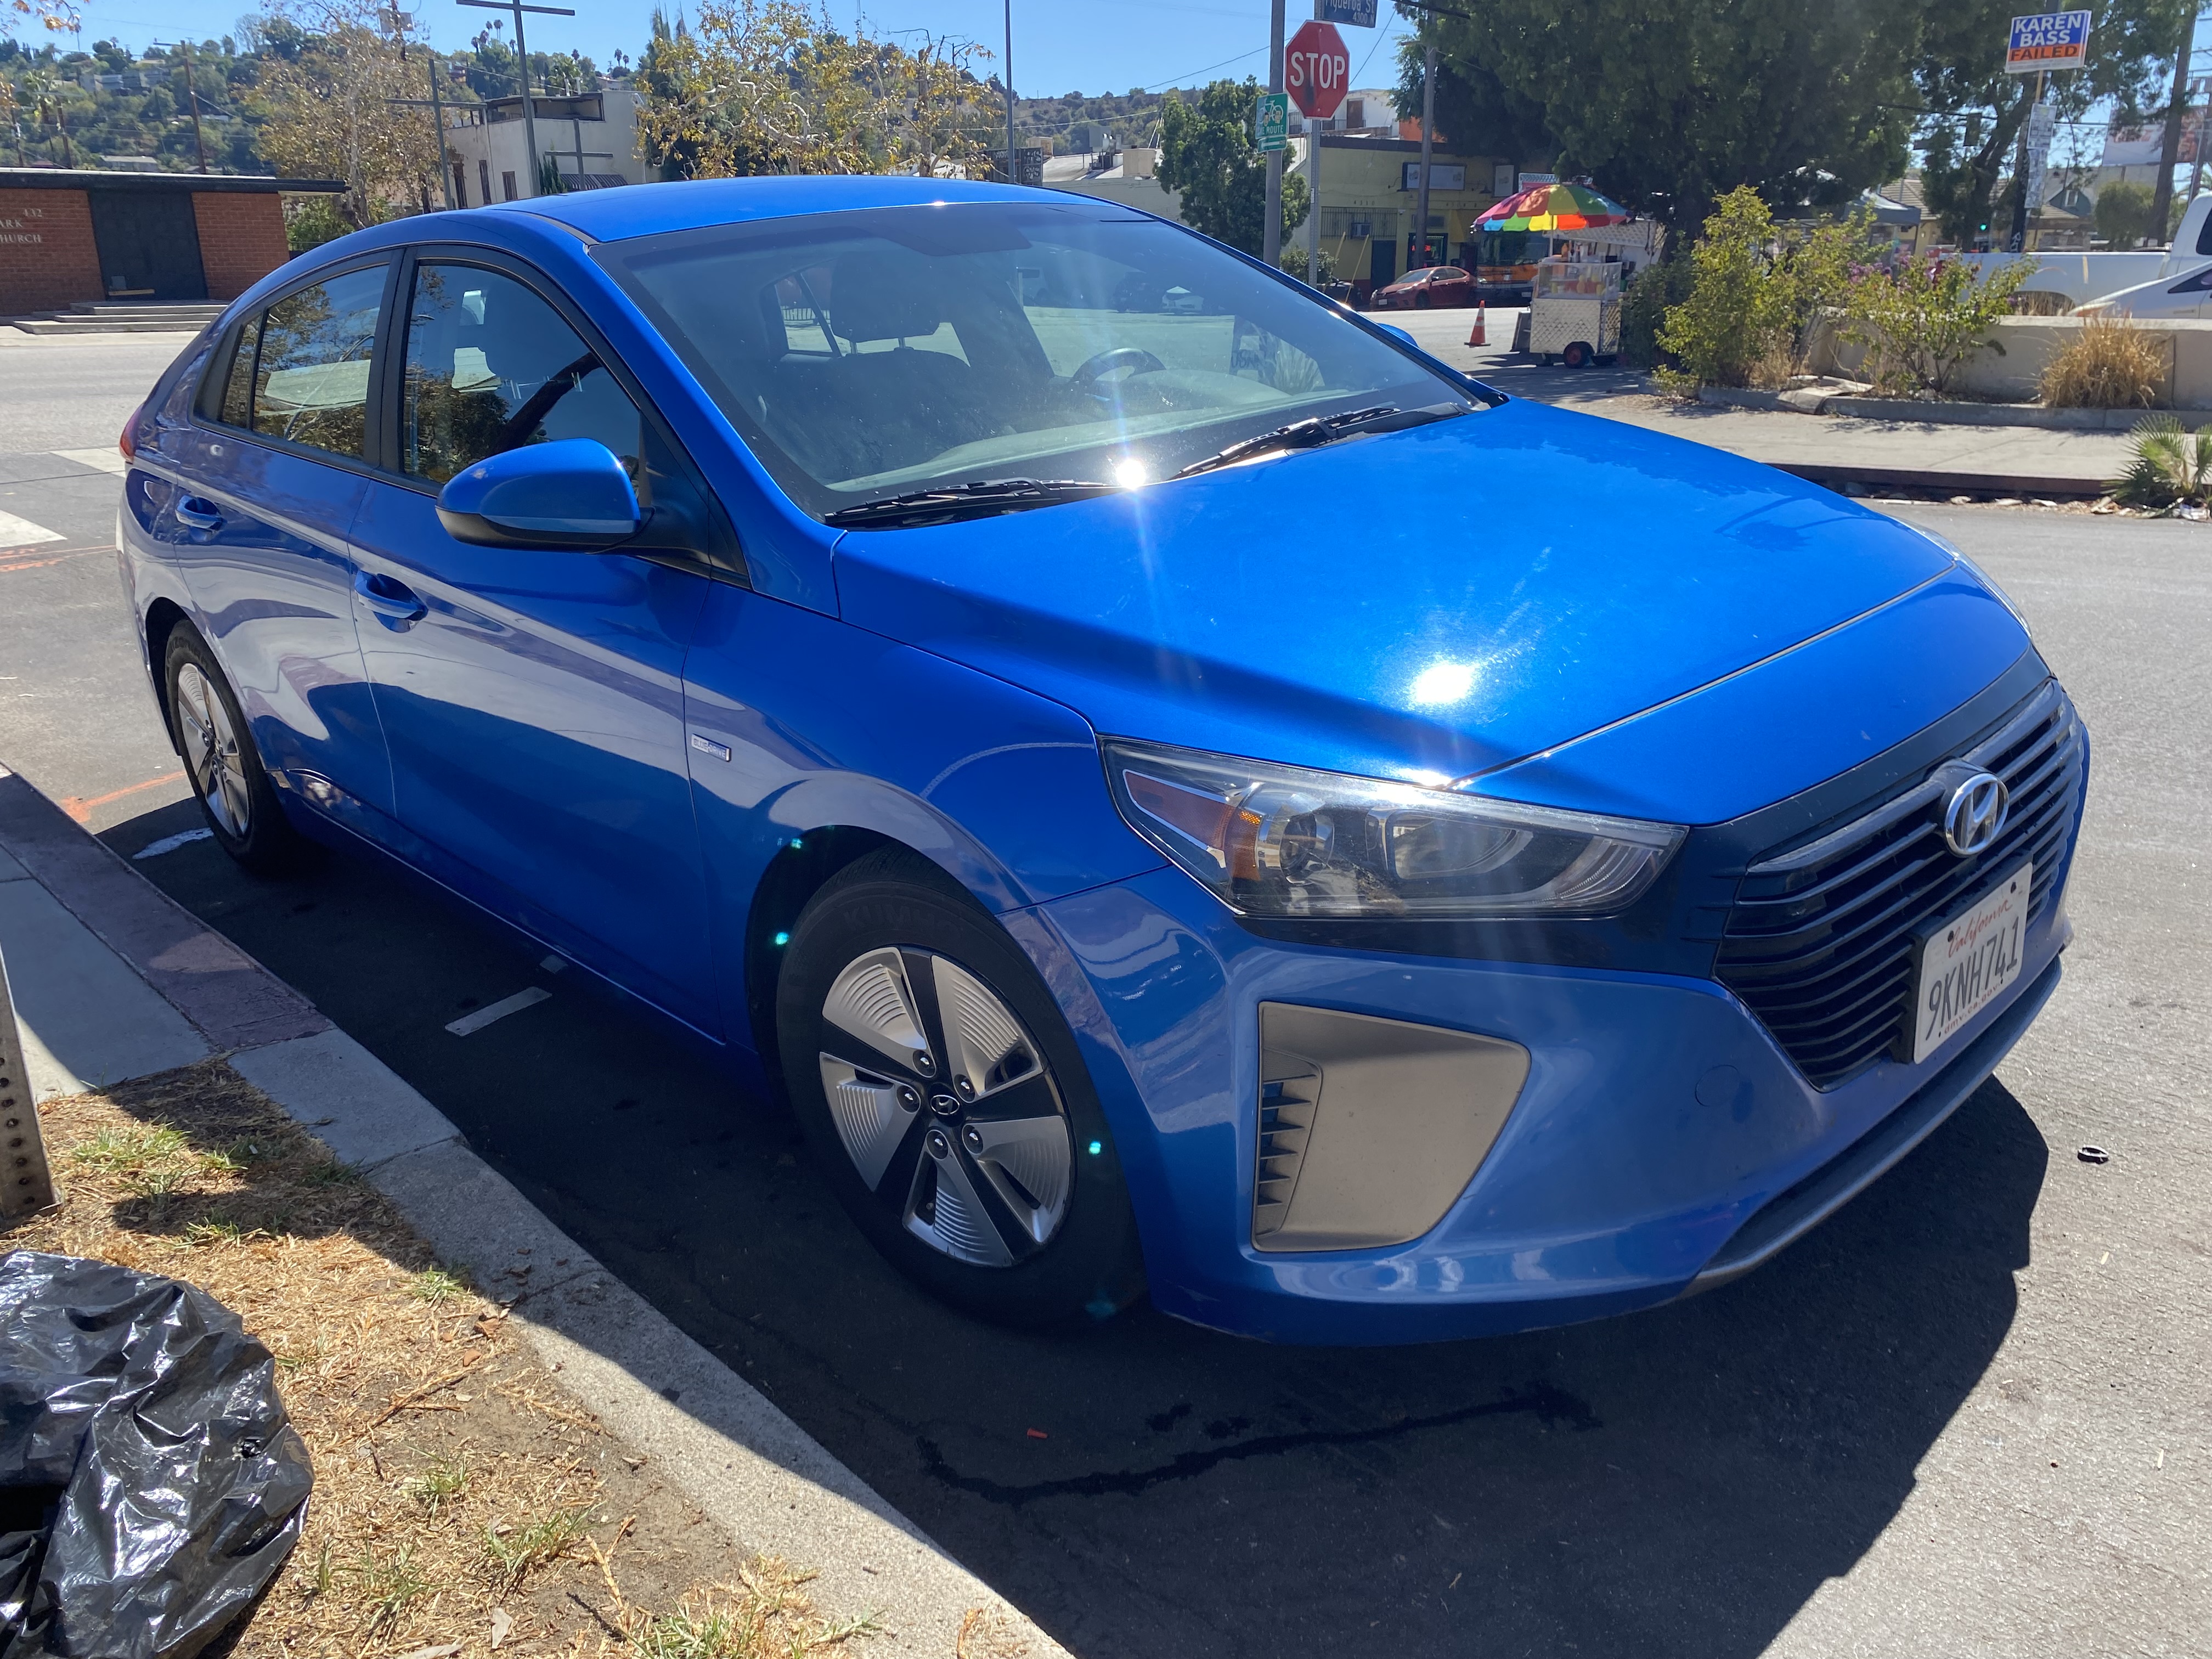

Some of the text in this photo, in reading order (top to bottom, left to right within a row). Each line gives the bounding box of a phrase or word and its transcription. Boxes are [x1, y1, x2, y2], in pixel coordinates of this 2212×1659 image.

[1365, 0, 1375, 13] St
[1352, 12, 1374, 24] 4300 N
[2015, 14, 2082, 33] KAREN
[2020, 30, 2070, 47] BASS
[2011, 46, 2078, 61] FAILED
[1290, 51, 1346, 89] STOP
[1266, 125, 1284, 135] ROUTE
[22, 208, 42, 217] 432
[1949, 899, 2013, 958] California
[1926, 916, 2019, 1041] 9KNH741
